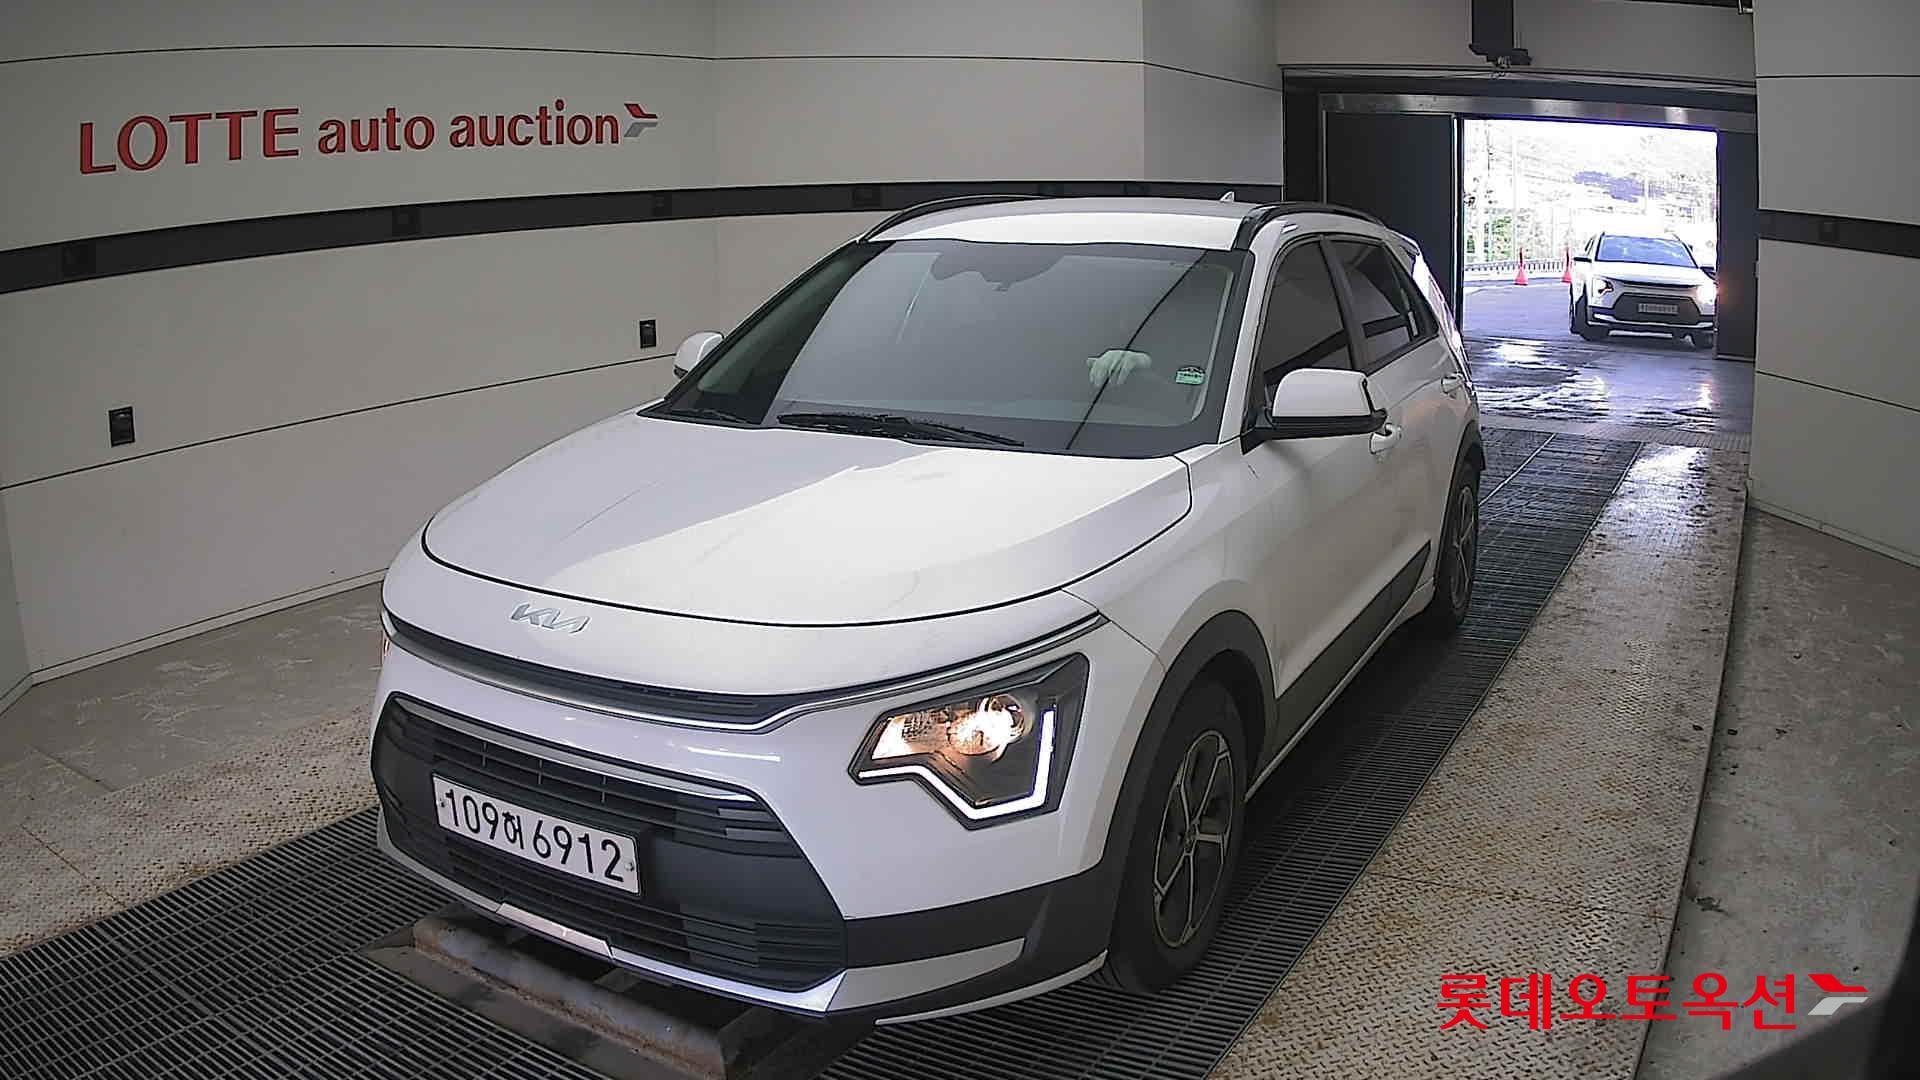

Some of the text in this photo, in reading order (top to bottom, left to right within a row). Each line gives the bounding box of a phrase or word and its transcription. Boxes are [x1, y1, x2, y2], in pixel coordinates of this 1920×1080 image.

[80, 100, 620, 174] LOTTE auto auction
